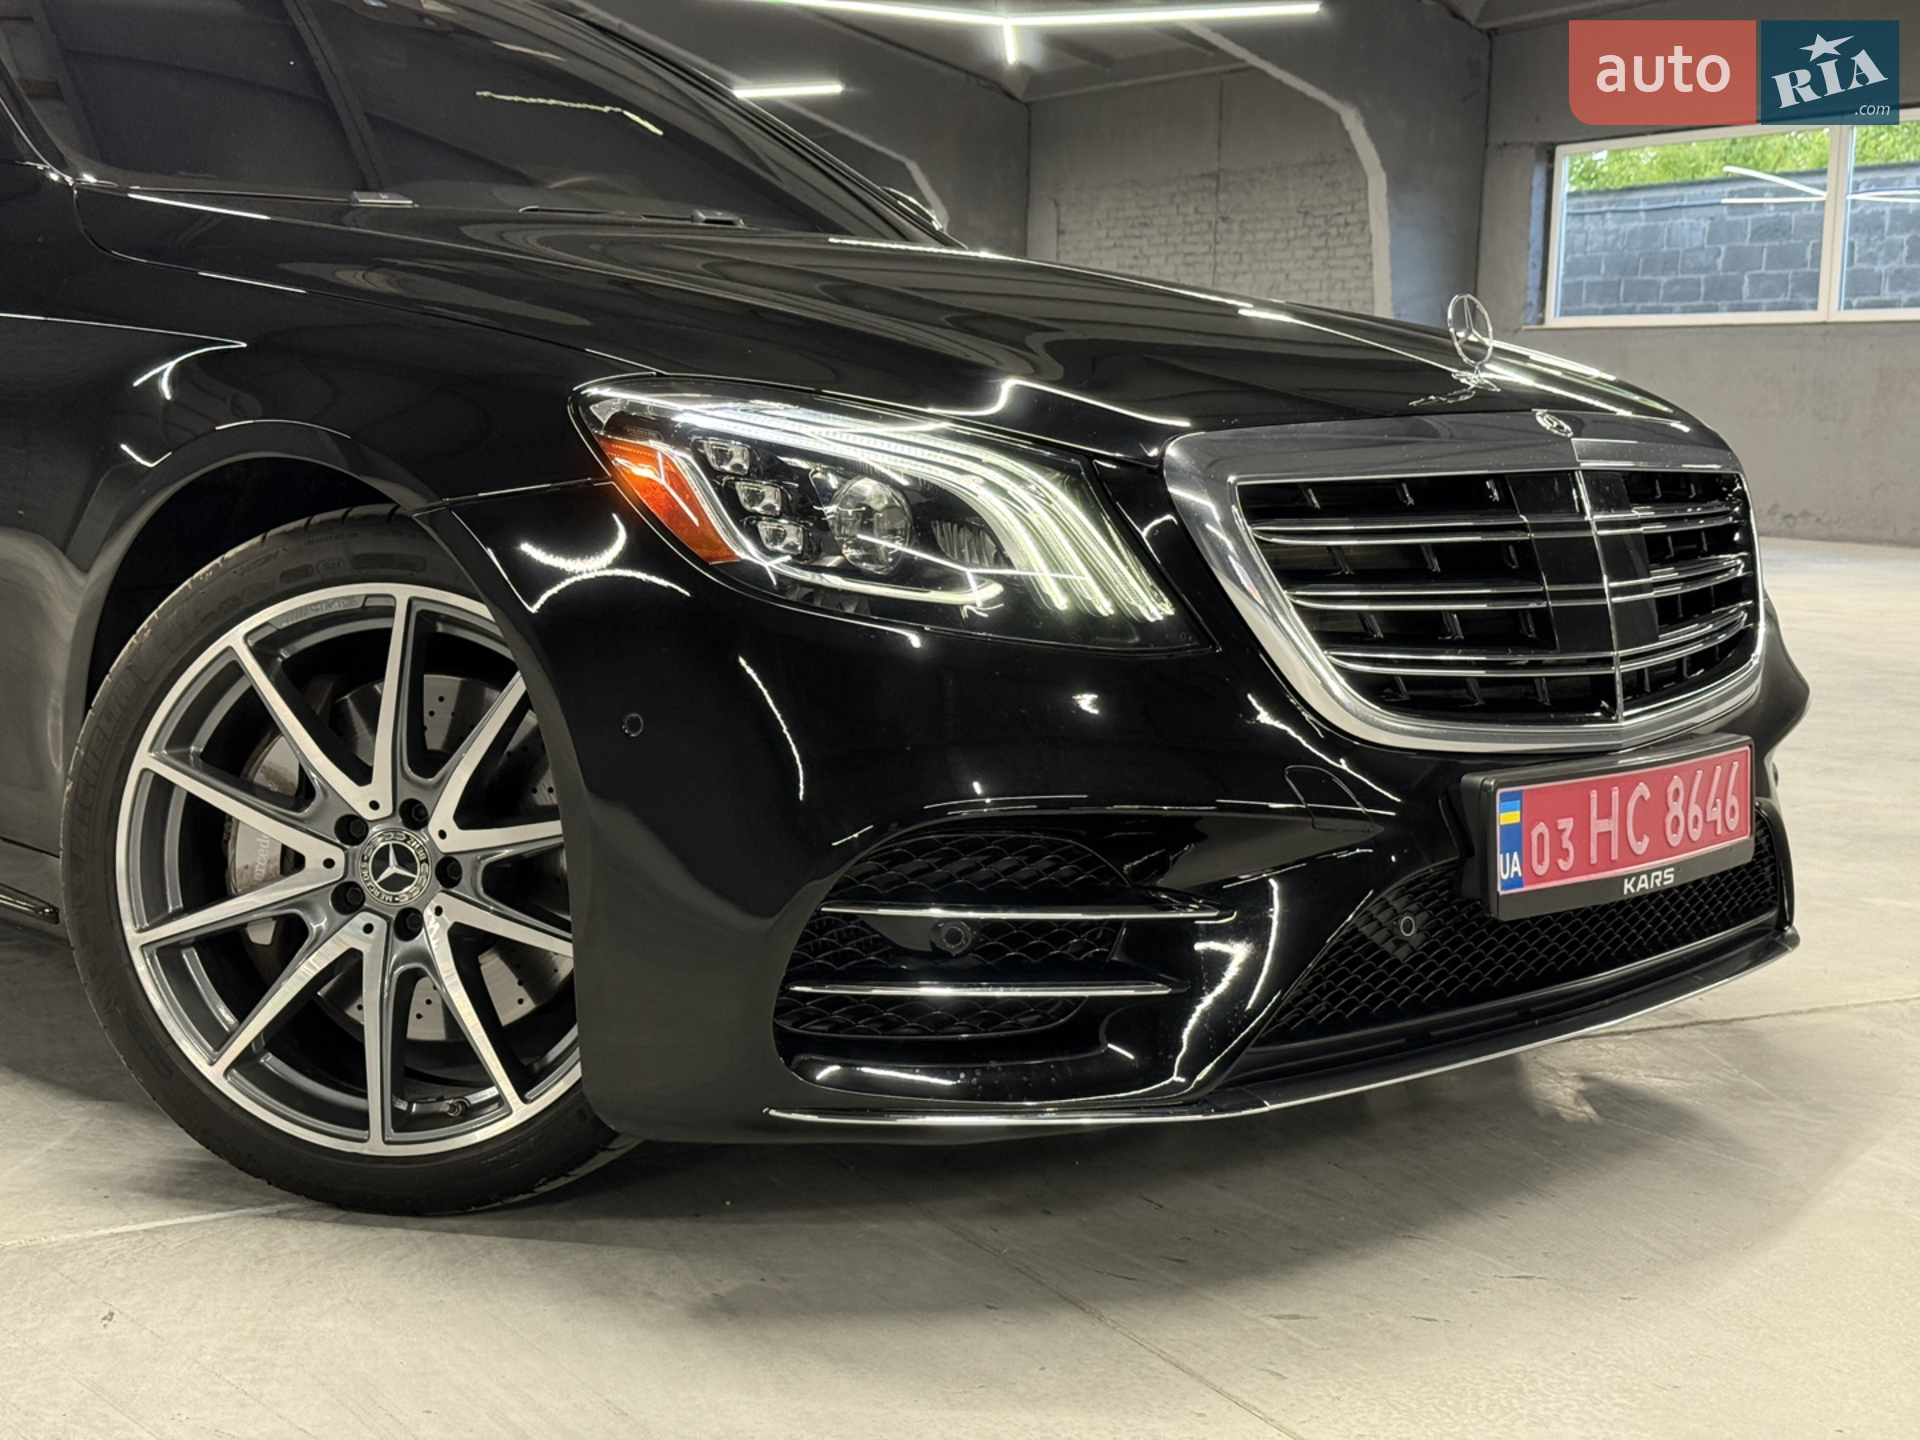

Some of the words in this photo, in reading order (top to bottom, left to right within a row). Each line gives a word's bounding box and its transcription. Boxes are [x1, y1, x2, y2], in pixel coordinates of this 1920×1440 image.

[1530, 817, 1574, 877] 03
[1590, 781, 1651, 865] HC
[1665, 760, 1740, 848] 8646
[1500, 851, 1522, 880] UA
[1623, 867, 1675, 896] KARS
